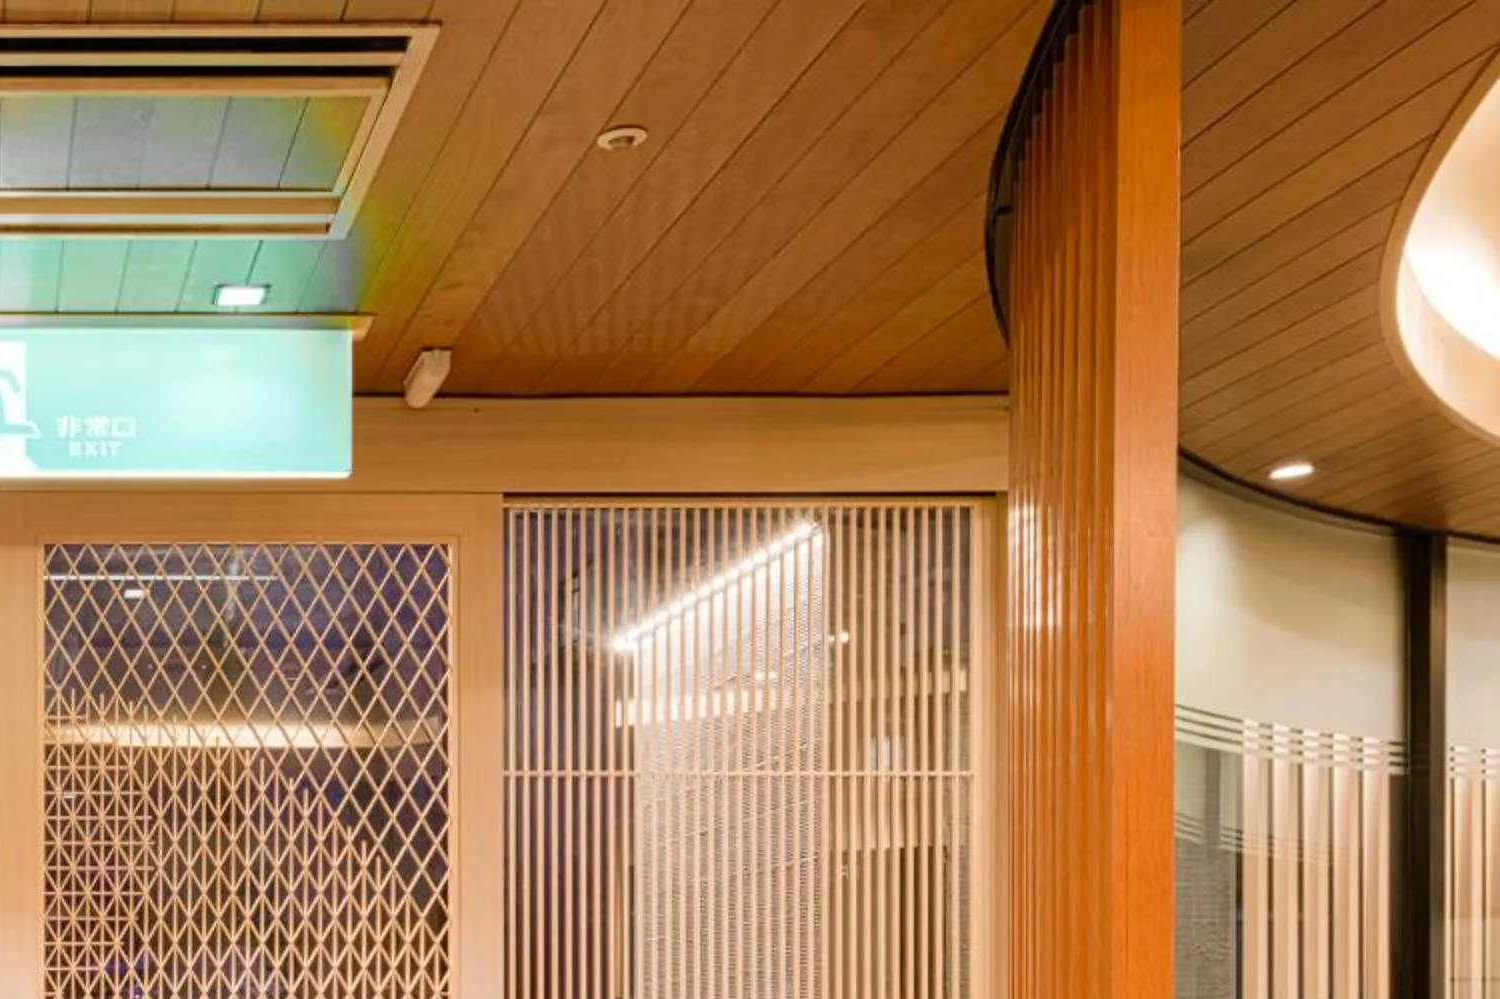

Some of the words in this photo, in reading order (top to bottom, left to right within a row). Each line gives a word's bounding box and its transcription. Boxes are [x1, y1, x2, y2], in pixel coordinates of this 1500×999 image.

[56, 415, 137, 439] 非常口
[69, 441, 122, 457] EXIT
